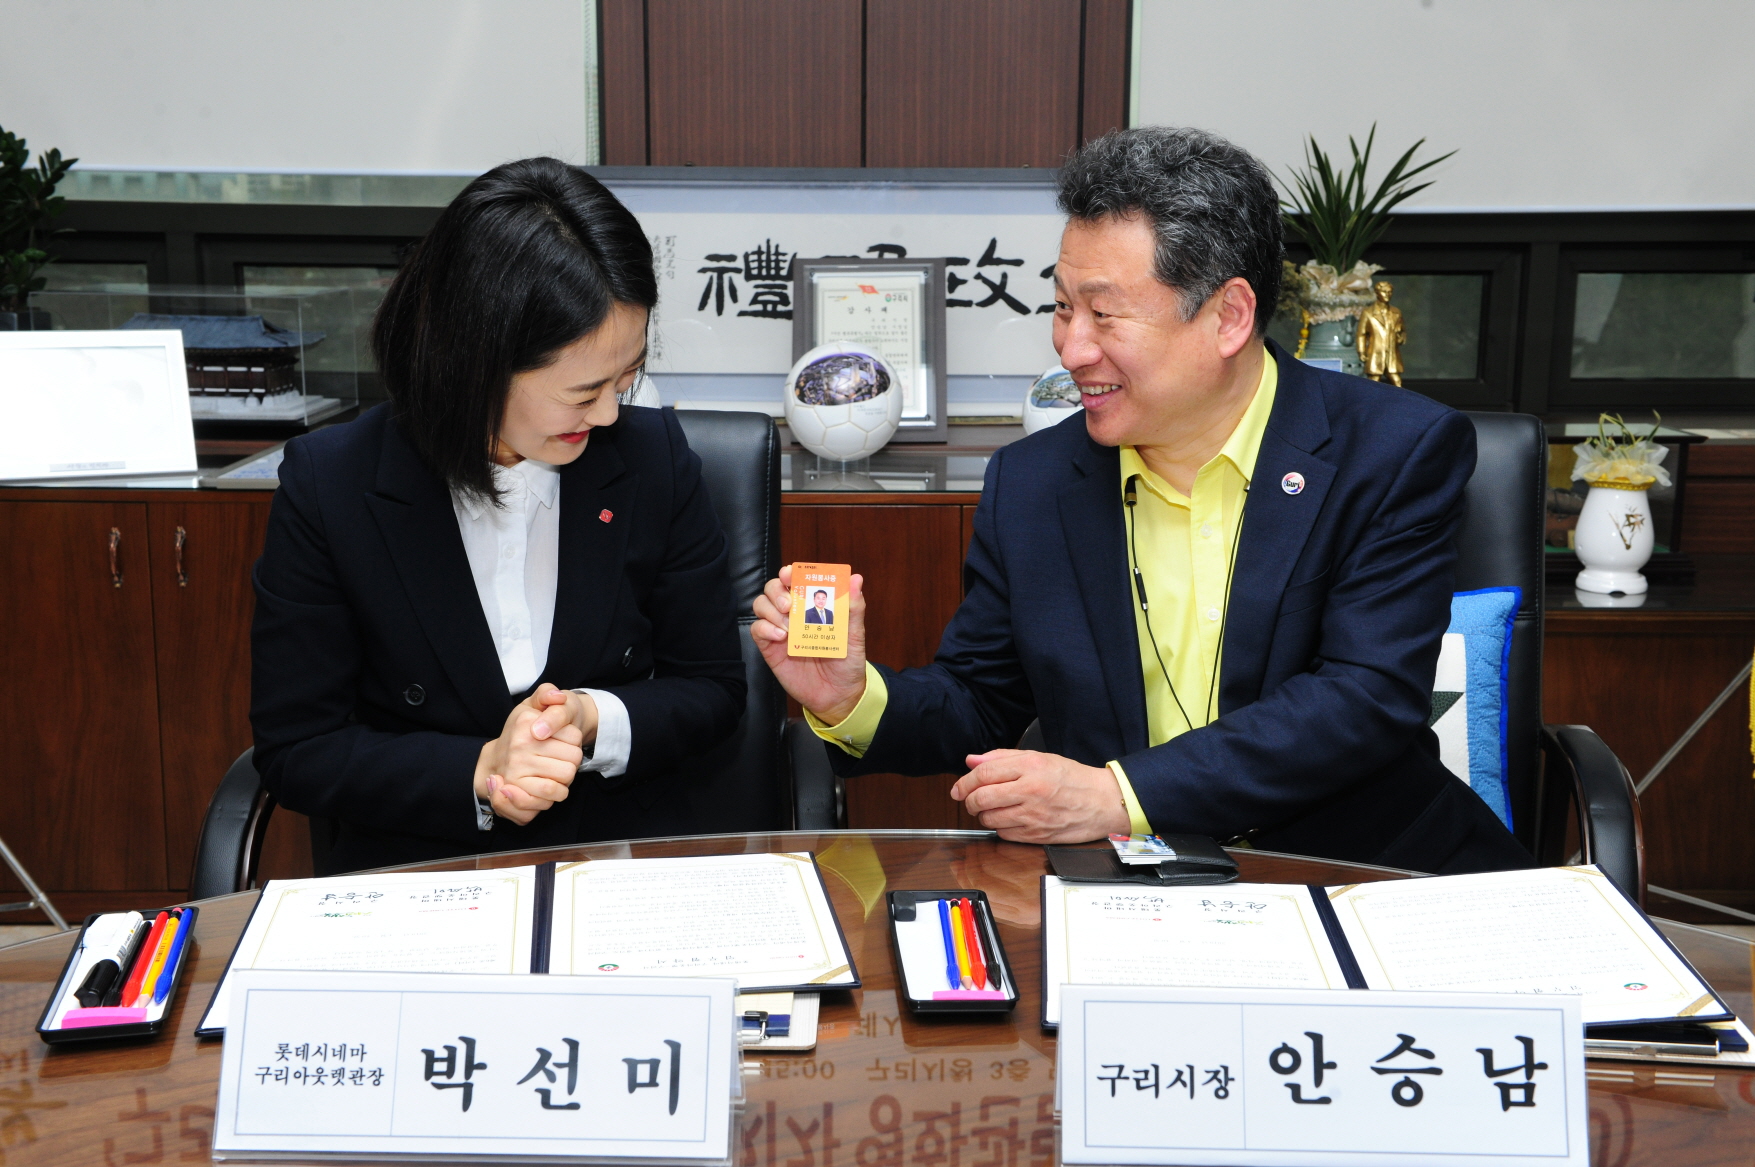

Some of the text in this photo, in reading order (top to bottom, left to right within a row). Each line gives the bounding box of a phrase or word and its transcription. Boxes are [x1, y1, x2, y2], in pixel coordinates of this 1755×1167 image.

[805, 573, 837, 582] 자원봉사증
[274, 1042, 368, 1064] 롯데시네마
[254, 1065, 385, 1088] 구리아웃렛관장
[1096, 1063, 1236, 1101] 구리시장
